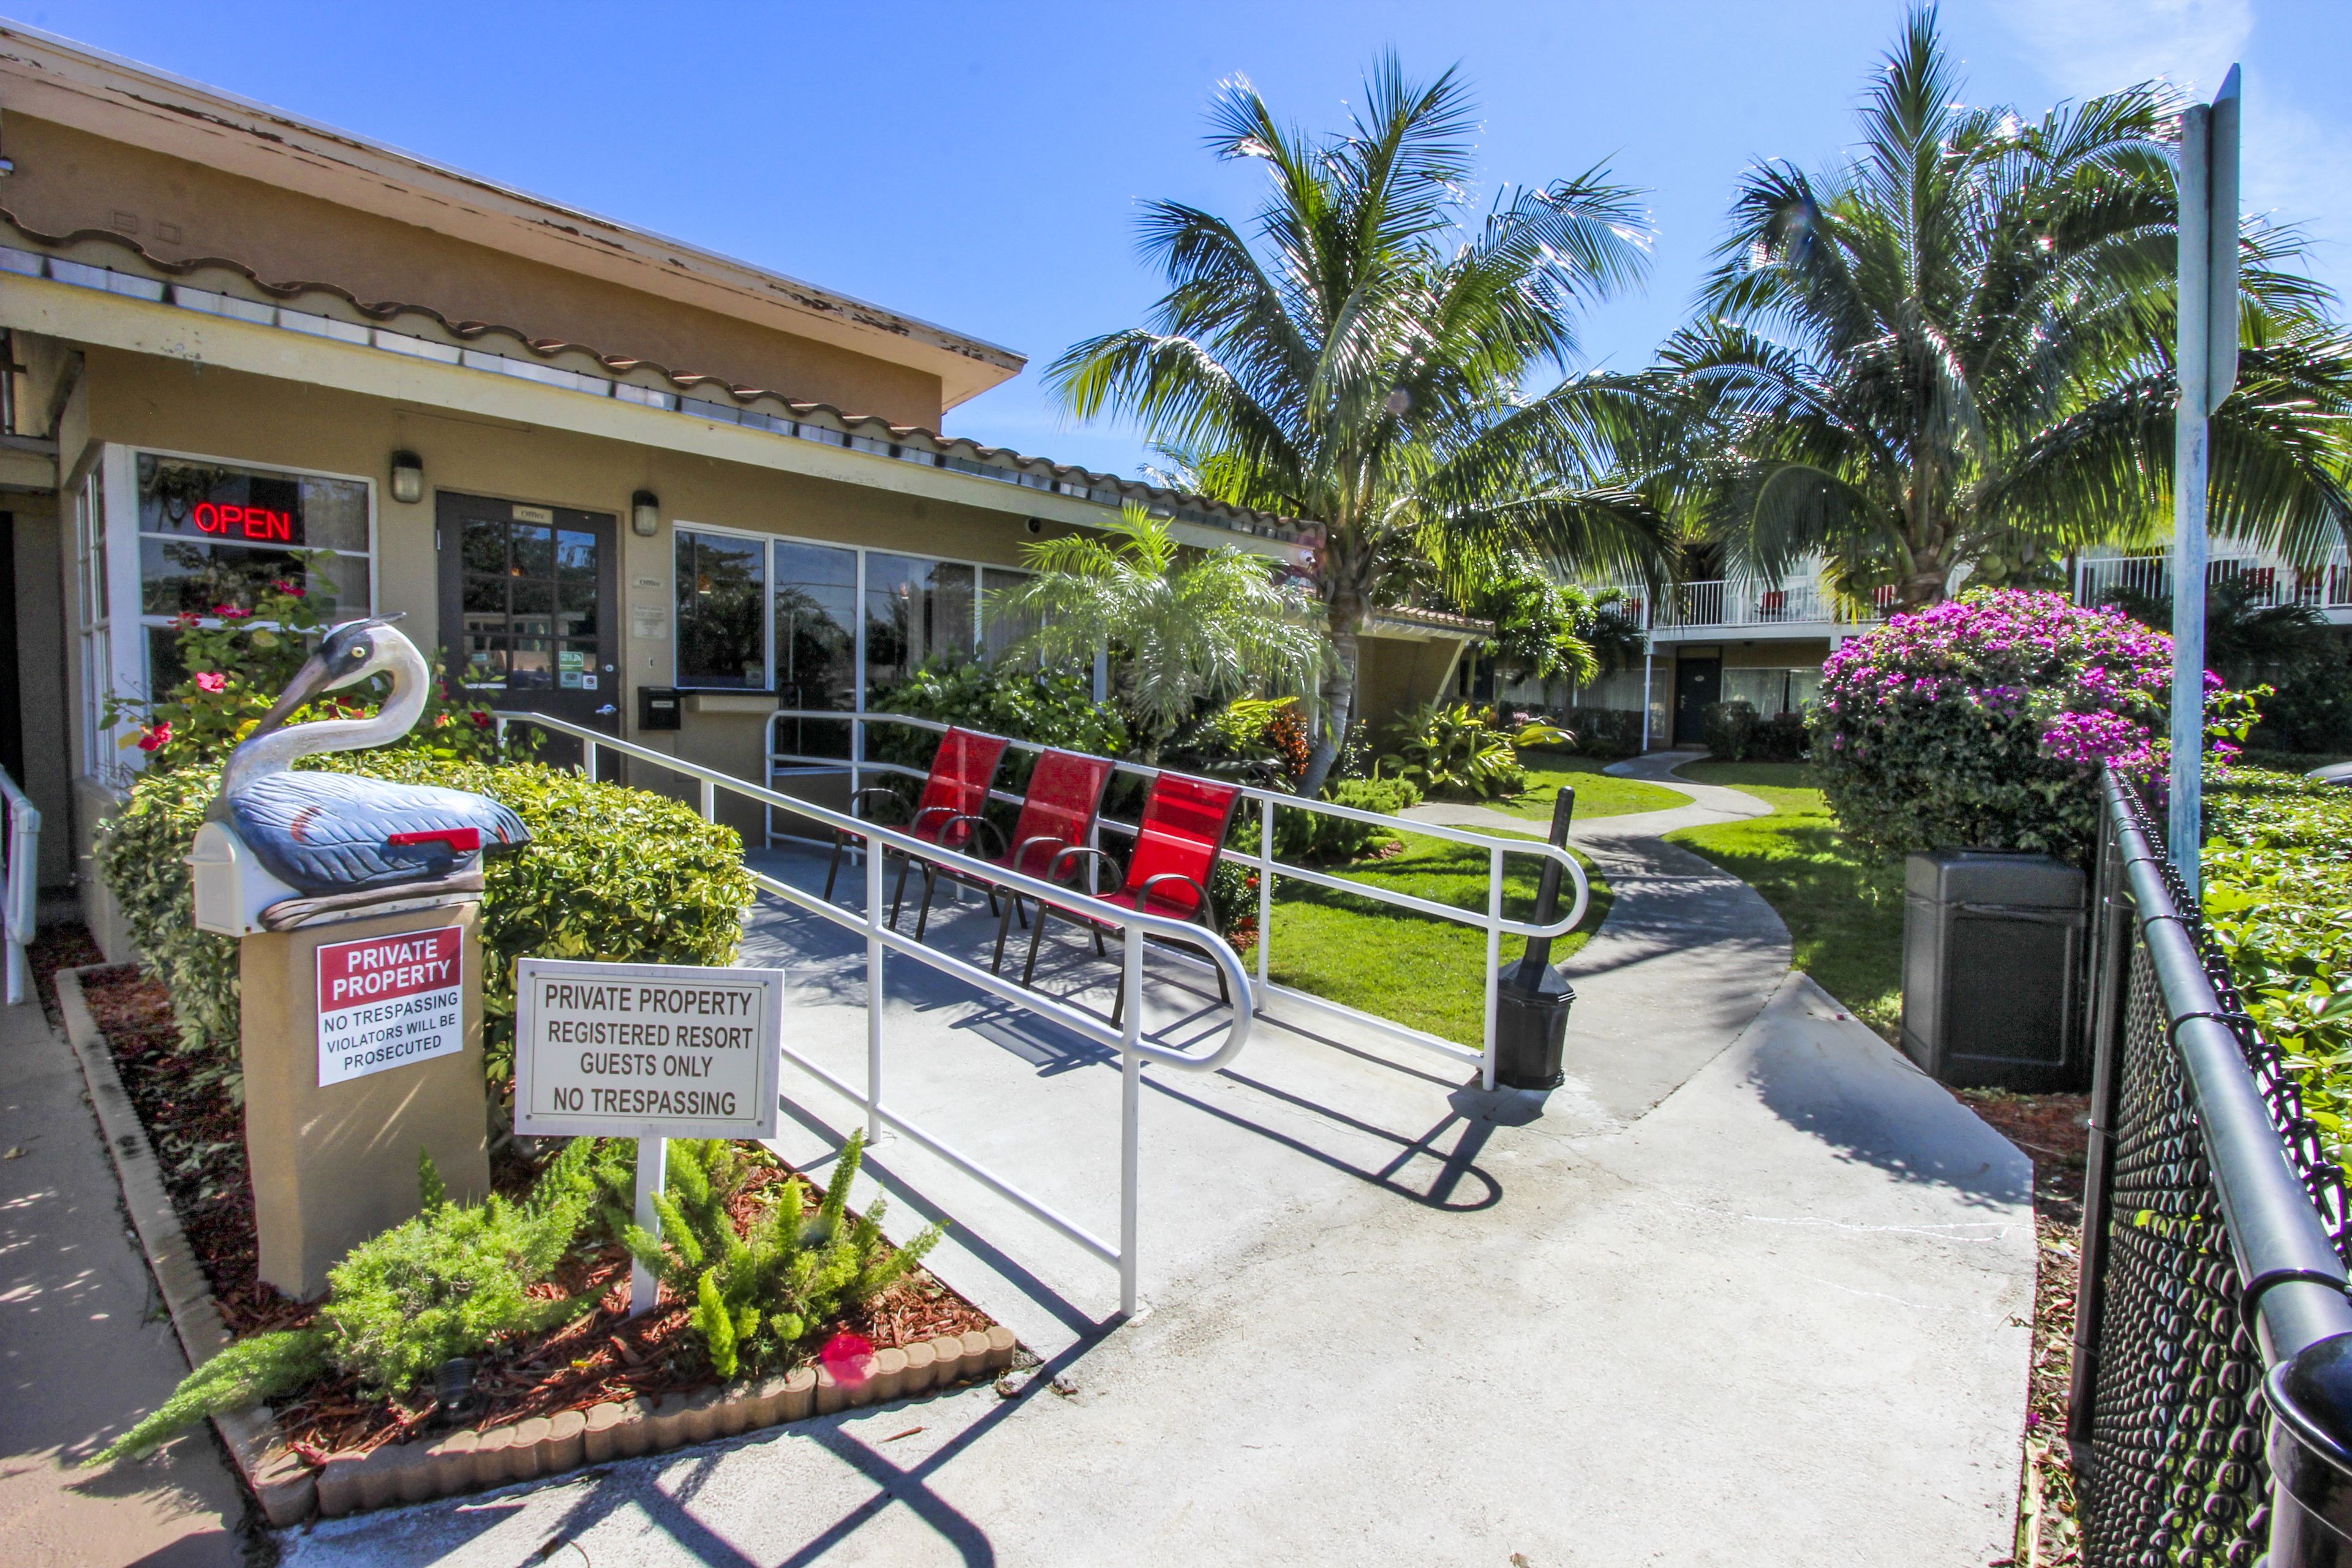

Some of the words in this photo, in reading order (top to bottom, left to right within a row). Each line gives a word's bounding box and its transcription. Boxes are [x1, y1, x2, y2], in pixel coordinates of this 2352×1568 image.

[194, 502, 290, 540] OPEN
[521, 510, 545, 519] Office
[348, 938, 438, 973] PRIVATE
[333, 959, 451, 1001] PROPERTY
[325, 1015, 347, 1033] NO
[353, 992, 458, 1027] TRESPASSING
[545, 984, 631, 1011] PRIVATE
[639, 988, 752, 1016] PROPERTY
[327, 1025, 403, 1054] VIOLATORS
[406, 1018, 436, 1035] WILL
[440, 1013, 456, 1027] BE
[548, 1020, 669, 1047] REGISTERED
[676, 1026, 753, 1049] RESORT
[344, 1035, 442, 1071] PROSECUTED
[581, 1052, 657, 1076] GUESTS
[663, 1054, 714, 1077] ONLY
[554, 1087, 584, 1112] NO
[591, 1087, 736, 1116] TRESPASSING
